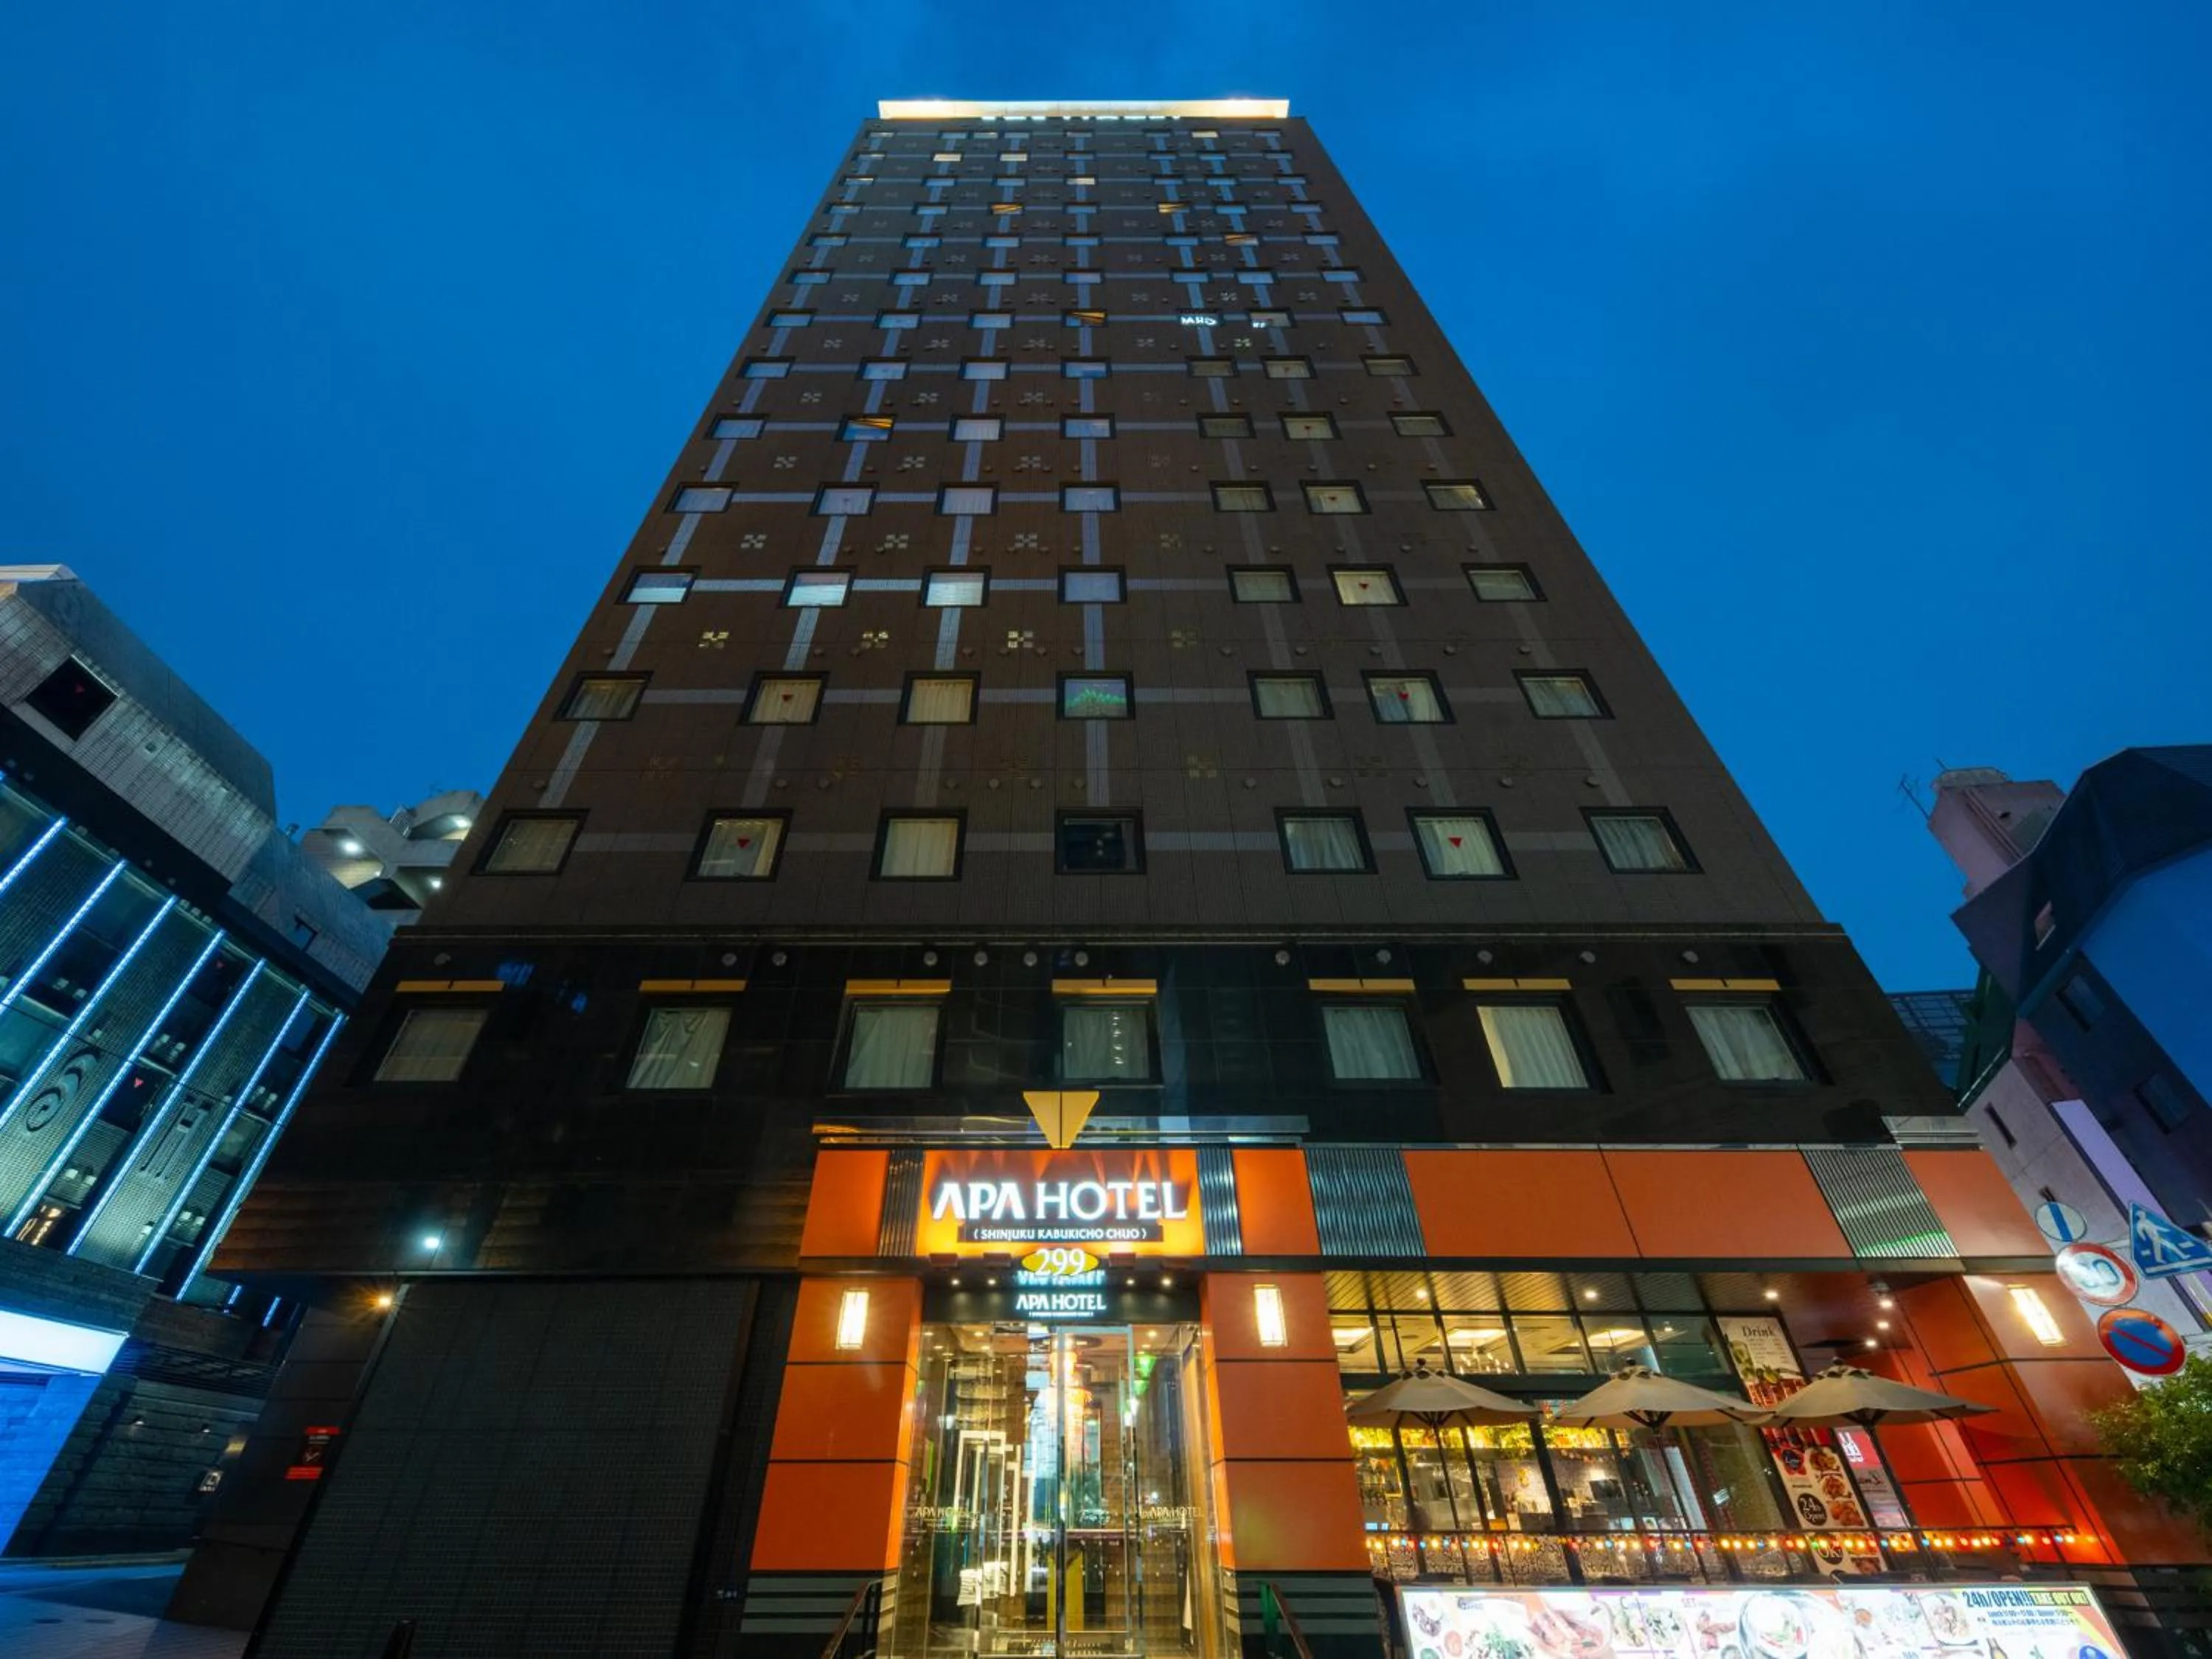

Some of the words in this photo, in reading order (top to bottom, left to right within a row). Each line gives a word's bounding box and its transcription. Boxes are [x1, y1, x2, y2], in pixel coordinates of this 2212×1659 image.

[931, 1181, 1026, 1221] APA
[1034, 1181, 1189, 1221] HOTEL
[1037, 1228, 1104, 1239] KABUKICHO
[1034, 1248, 1086, 1276] 299
[1015, 1293, 1049, 1310] APA
[1051, 1293, 1107, 1310] HOTEL
[1742, 1326, 1775, 1338] Drink
